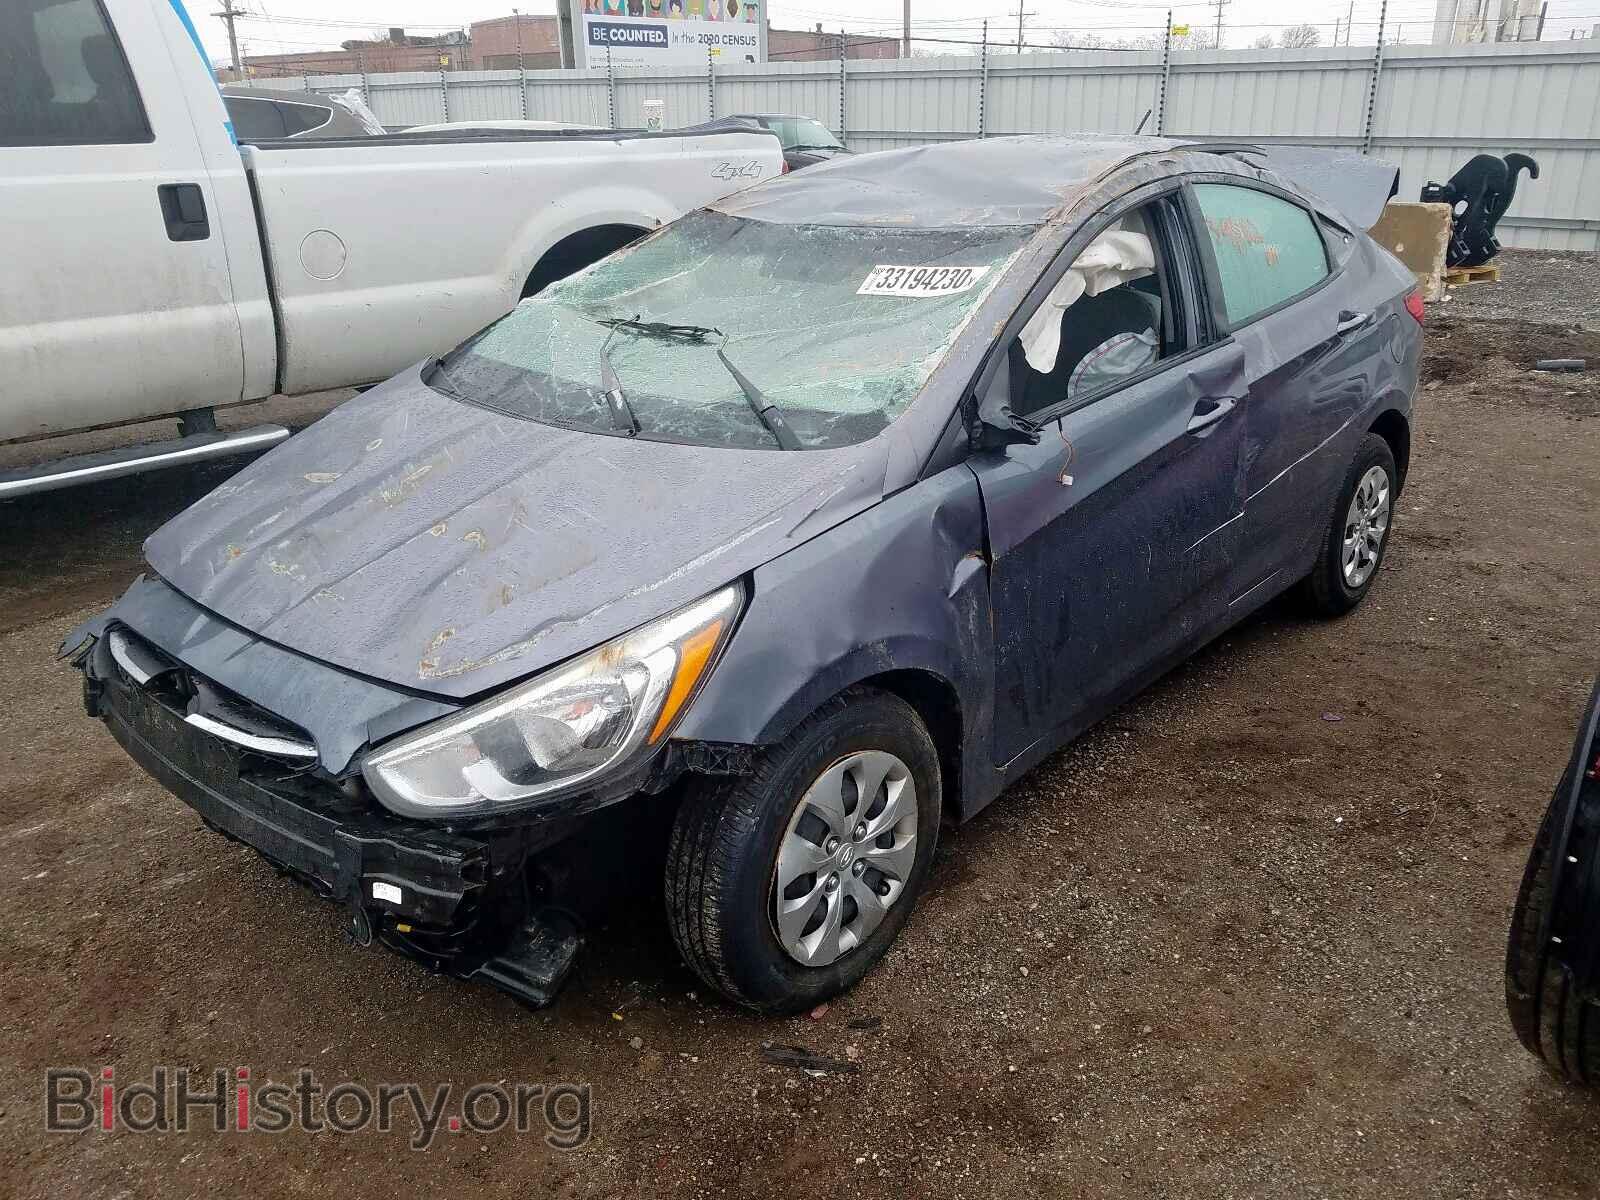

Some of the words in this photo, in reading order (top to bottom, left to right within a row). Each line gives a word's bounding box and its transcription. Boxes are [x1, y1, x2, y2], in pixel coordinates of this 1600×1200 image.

[593, 28, 607, 41] BE
[609, 28, 667, 43] COUNTED.
[682, 30, 695, 43] the
[698, 33, 720, 44] 2020
[722, 34, 757, 46] CENSUS
[711, 160, 763, 180] 4x4
[876, 267, 973, 290] 33194230
